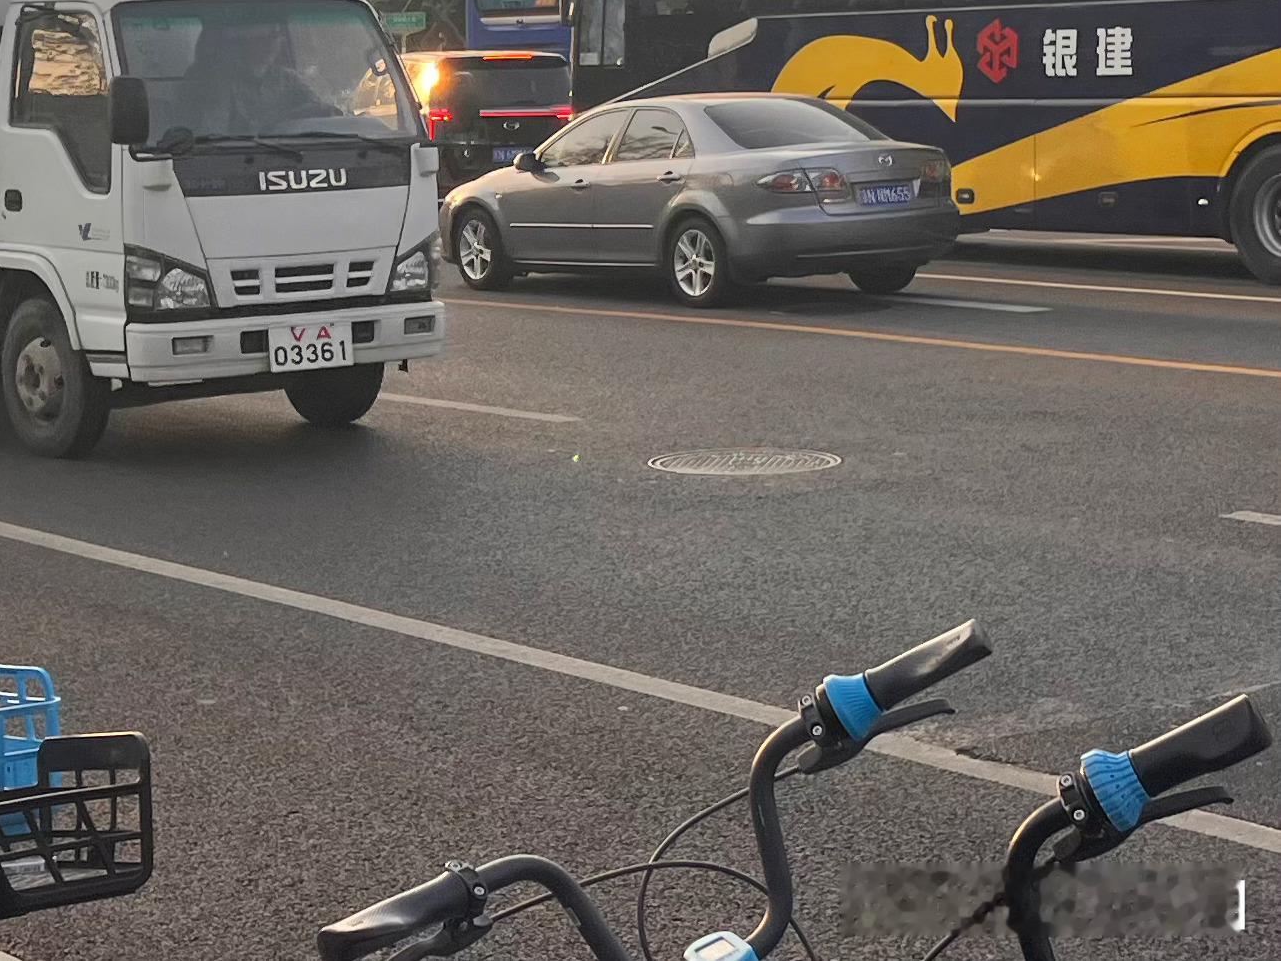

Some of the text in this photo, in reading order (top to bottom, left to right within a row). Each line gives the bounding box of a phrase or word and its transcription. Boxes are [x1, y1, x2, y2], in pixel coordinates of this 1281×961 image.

[1042, 26, 1133, 77] 银建
[258, 168, 347, 191] ISUZU
[274, 340, 347, 367] 03361
